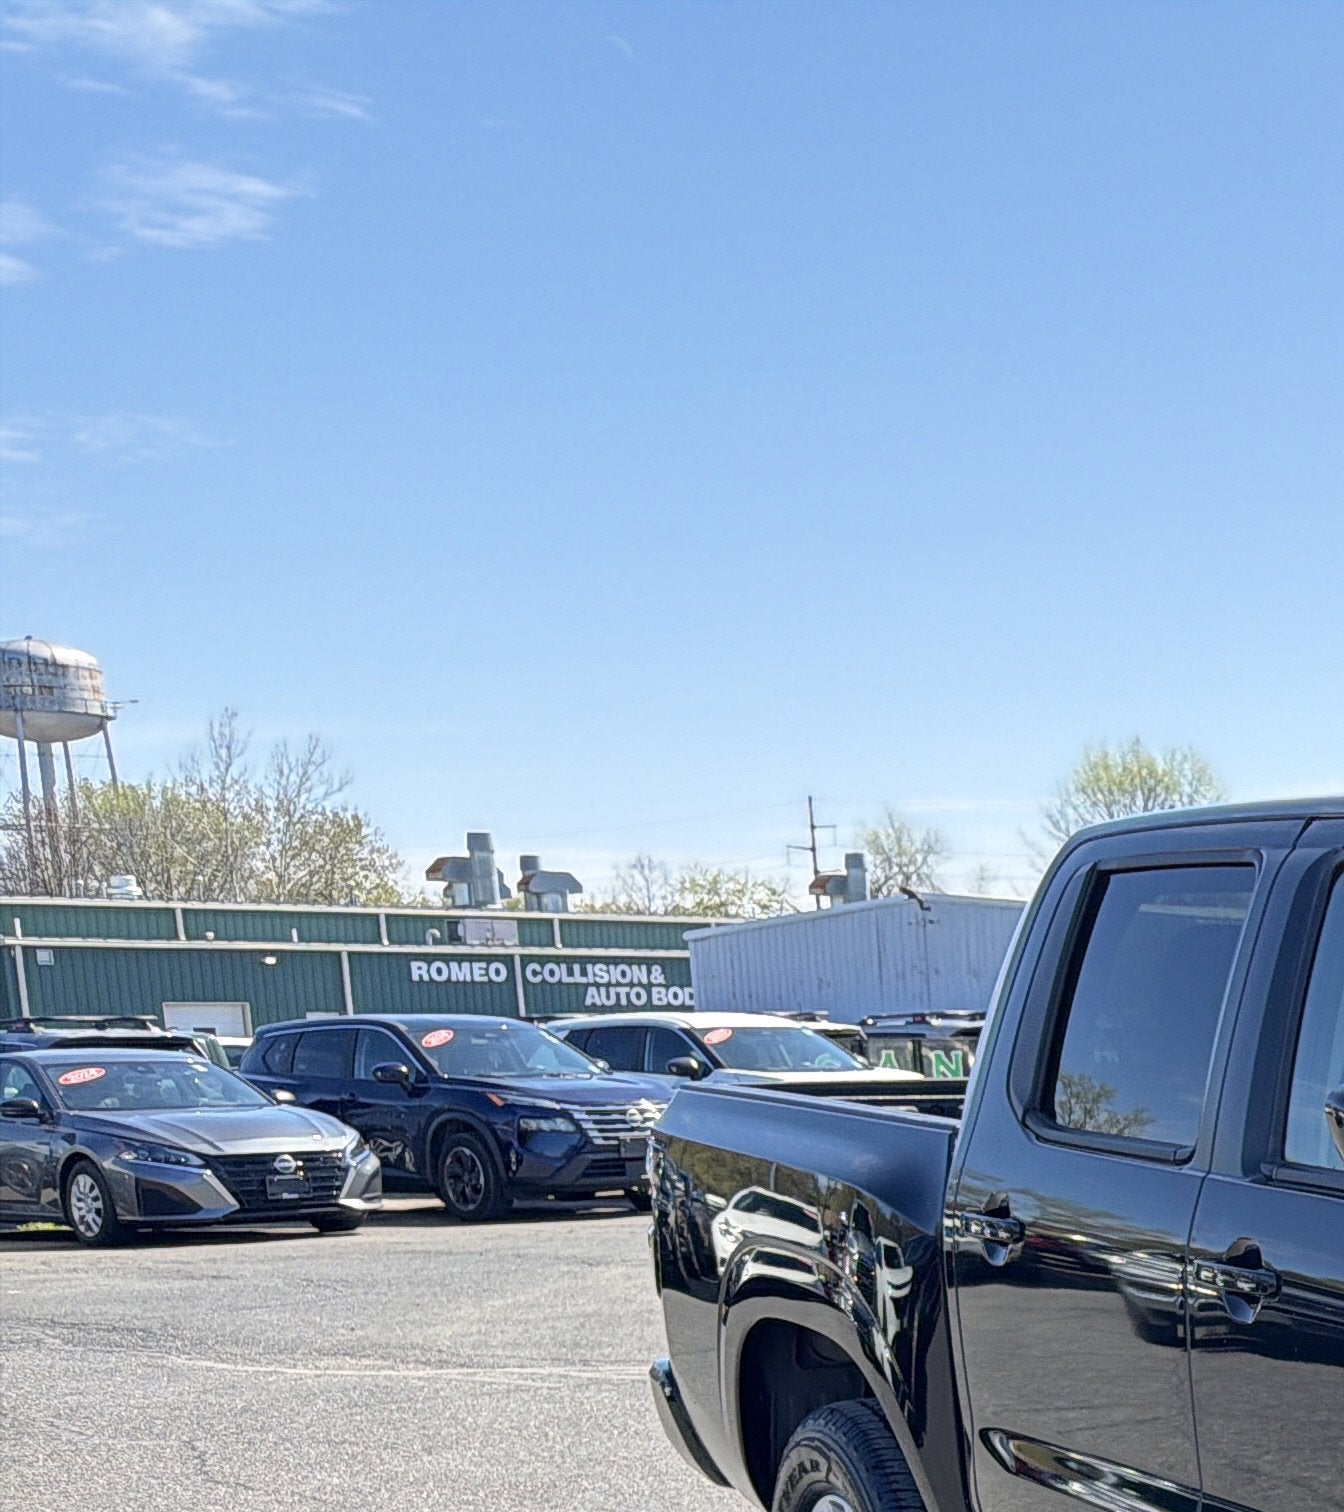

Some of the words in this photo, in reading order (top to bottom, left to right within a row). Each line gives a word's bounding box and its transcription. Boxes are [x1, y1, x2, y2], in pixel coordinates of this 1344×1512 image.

[410, 960, 508, 982] ROMEO
[525, 962, 648, 984] COLLISION
[649, 964, 666, 984] &
[584, 987, 648, 1007] AUTO
[651, 987, 696, 1007] BOD
